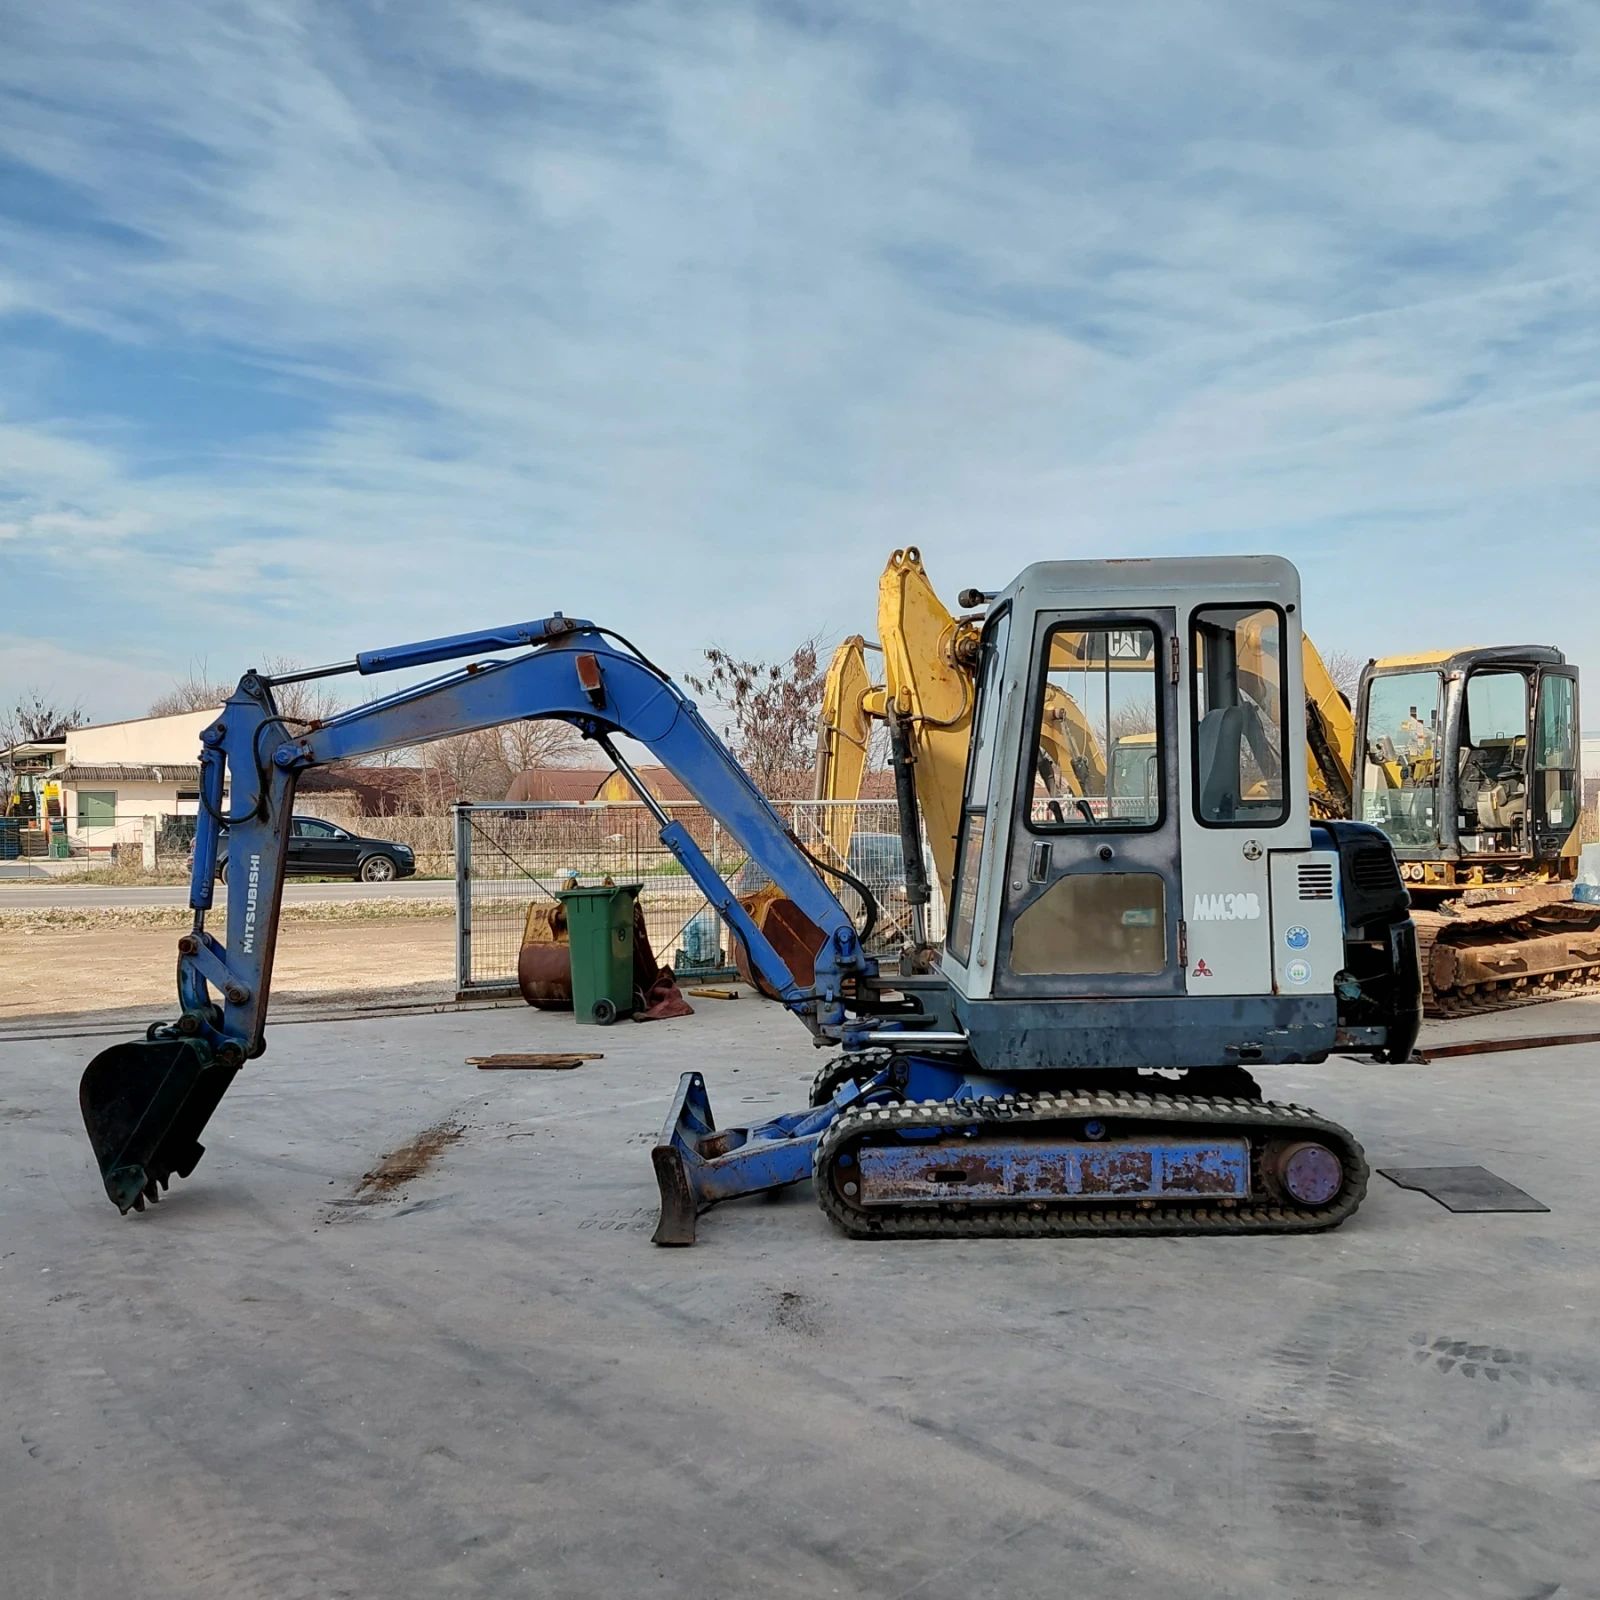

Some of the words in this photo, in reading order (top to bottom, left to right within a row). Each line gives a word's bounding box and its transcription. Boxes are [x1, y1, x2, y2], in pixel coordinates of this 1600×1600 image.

[1109, 630, 1143, 658] CAT
[243, 854, 260, 954] MITSUBISHI
[1192, 892, 1261, 921] MM30B
